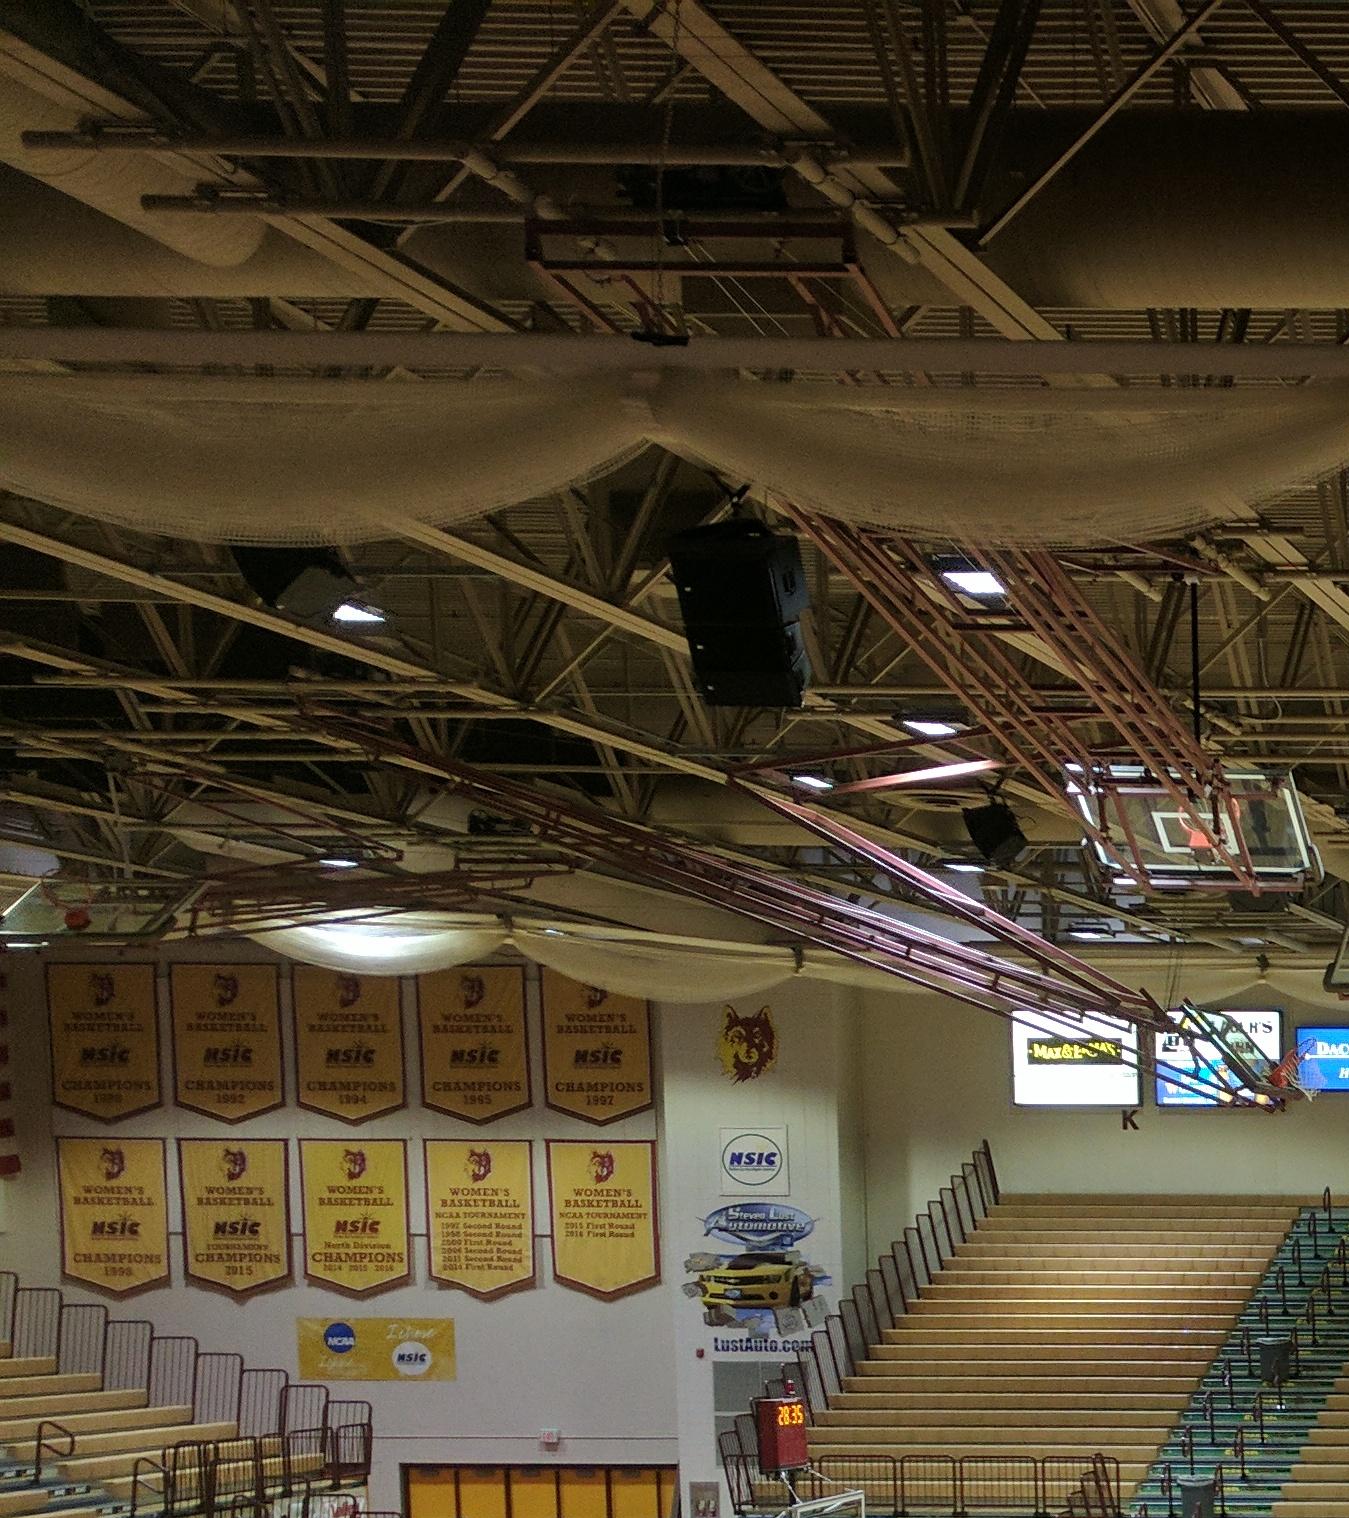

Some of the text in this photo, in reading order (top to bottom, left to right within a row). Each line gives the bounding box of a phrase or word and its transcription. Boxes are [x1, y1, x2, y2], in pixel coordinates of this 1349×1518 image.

[556, 1024, 637, 1035] BASKETBALL
[306, 1081, 397, 1092] CHAMPIONS
[432, 1081, 522, 1092] CHAMPIONS
[555, 1081, 645, 1093] CHAMPIONS
[1122, 1109, 1140, 1130] K
[729, 1152, 778, 1166] NSIC
[327, 1185, 385, 1195] WOMEN'S
[449, 1187, 511, 1197] WOMEN'S
[573, 1188, 633, 1198] WOMEN'S
[73, 1196, 154, 1207] BASKETBALL
[197, 1196, 275, 1207] BASKETBALL
[318, 1196, 395, 1207] BASKETBALL
[440, 1198, 520, 1208] BASKETBALL
[564, 1199, 643, 1209] BASKETBALL
[435, 1211, 526, 1220] NCAA TOURNAMENT
[586, 1212, 648, 1220] TOURNAMENT
[494, 1222, 523, 1230] Round
[608, 1222, 635, 1230] Round
[608, 1231, 635, 1239] Round
[73, 1253, 162, 1265] CHAMPIONS
[194, 1252, 282, 1265] CHAMPIONS
[311, 1251, 404, 1264] CHAMPIONS
